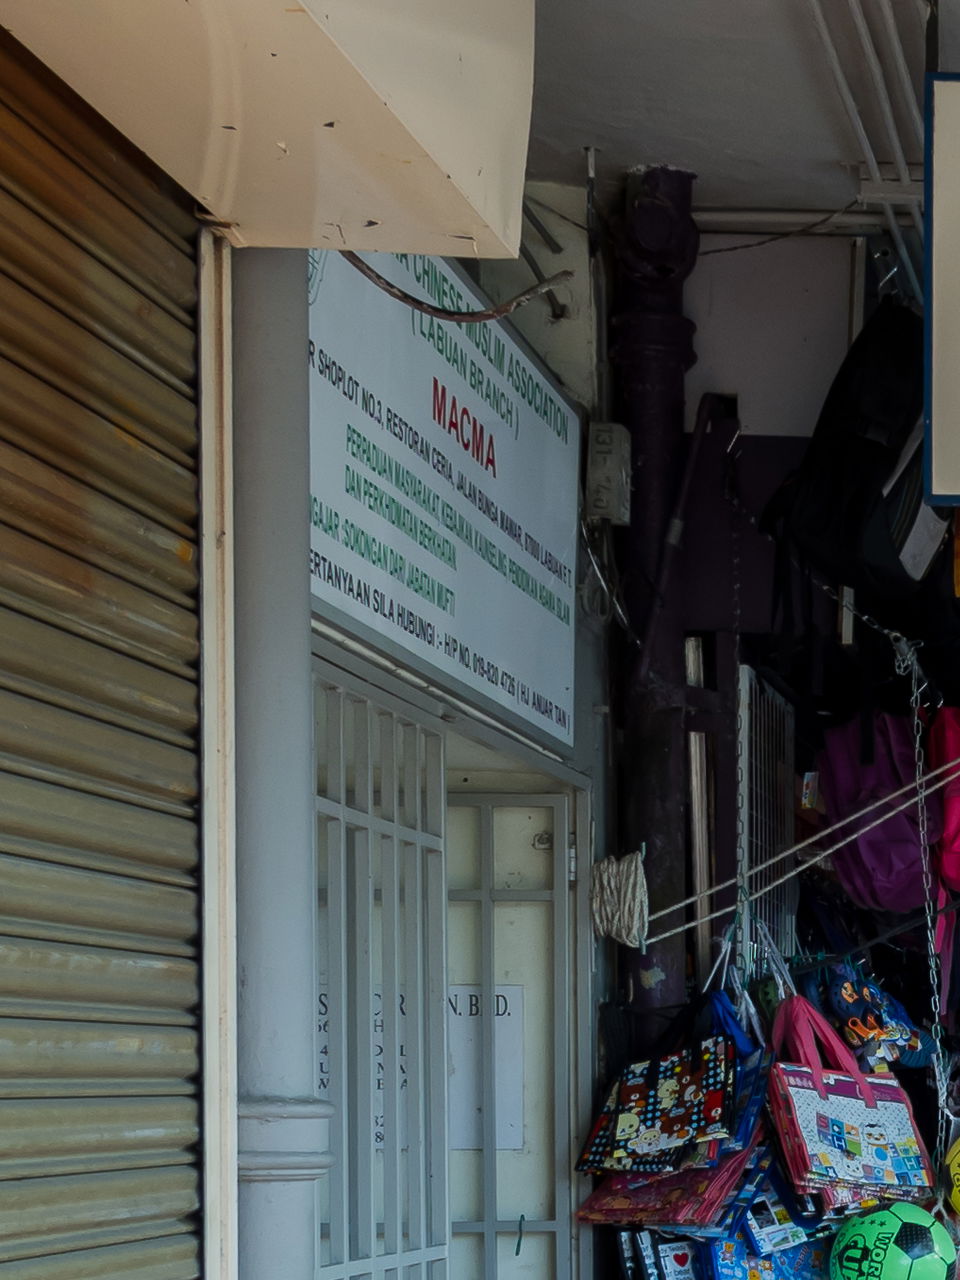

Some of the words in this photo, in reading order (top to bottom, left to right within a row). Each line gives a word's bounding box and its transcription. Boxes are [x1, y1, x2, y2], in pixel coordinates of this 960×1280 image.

[420, 311, 467, 380] LABUAN
[469, 359, 513, 428] BRANCH
[507, 353, 568, 445] ASSOCIATION
[318, 349, 359, 405] SHOPLOT
[386, 407, 431, 464] RESTORAN
[457, 470, 478, 507] JALAN
[346, 424, 393, 484] PERPADUAN
[433, 376, 497, 478] MACMA
[345, 464, 362, 503] DAN
[372, 588, 396, 623] SILA
[397, 603, 436, 647] HUBUNGI
[469, 993, 511, 1016] BD.
